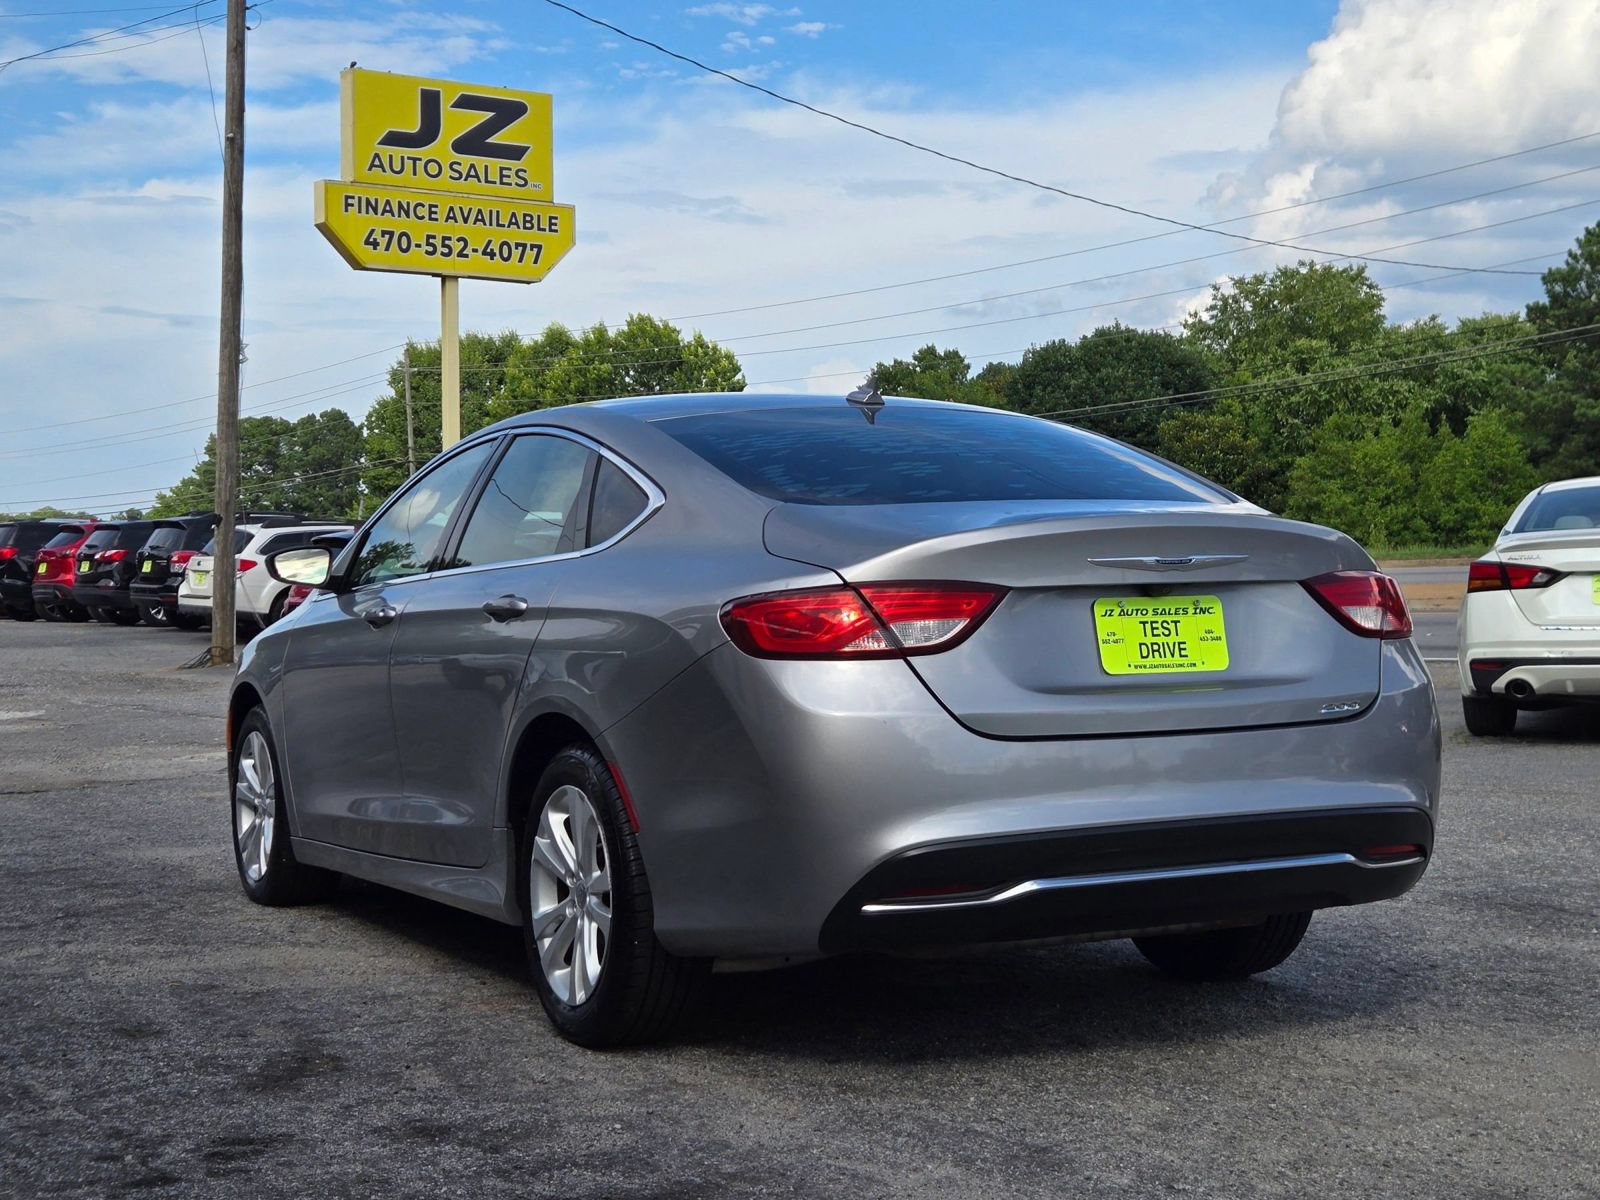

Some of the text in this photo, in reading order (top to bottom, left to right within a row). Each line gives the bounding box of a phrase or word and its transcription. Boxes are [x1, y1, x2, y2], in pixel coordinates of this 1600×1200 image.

[376, 87, 532, 161] JZ
[367, 152, 443, 179] AUTO
[449, 161, 529, 188] SALES
[343, 194, 559, 233] FINANCE AVAILABLE
[363, 228, 543, 265] 470-552-4077
[1101, 609, 1115, 617] JZ
[1118, 608, 1149, 617] AUTO
[1152, 607, 1189, 616] SALES
[1139, 620, 1181, 637] TEST
[1138, 641, 1189, 659] DRIVE
